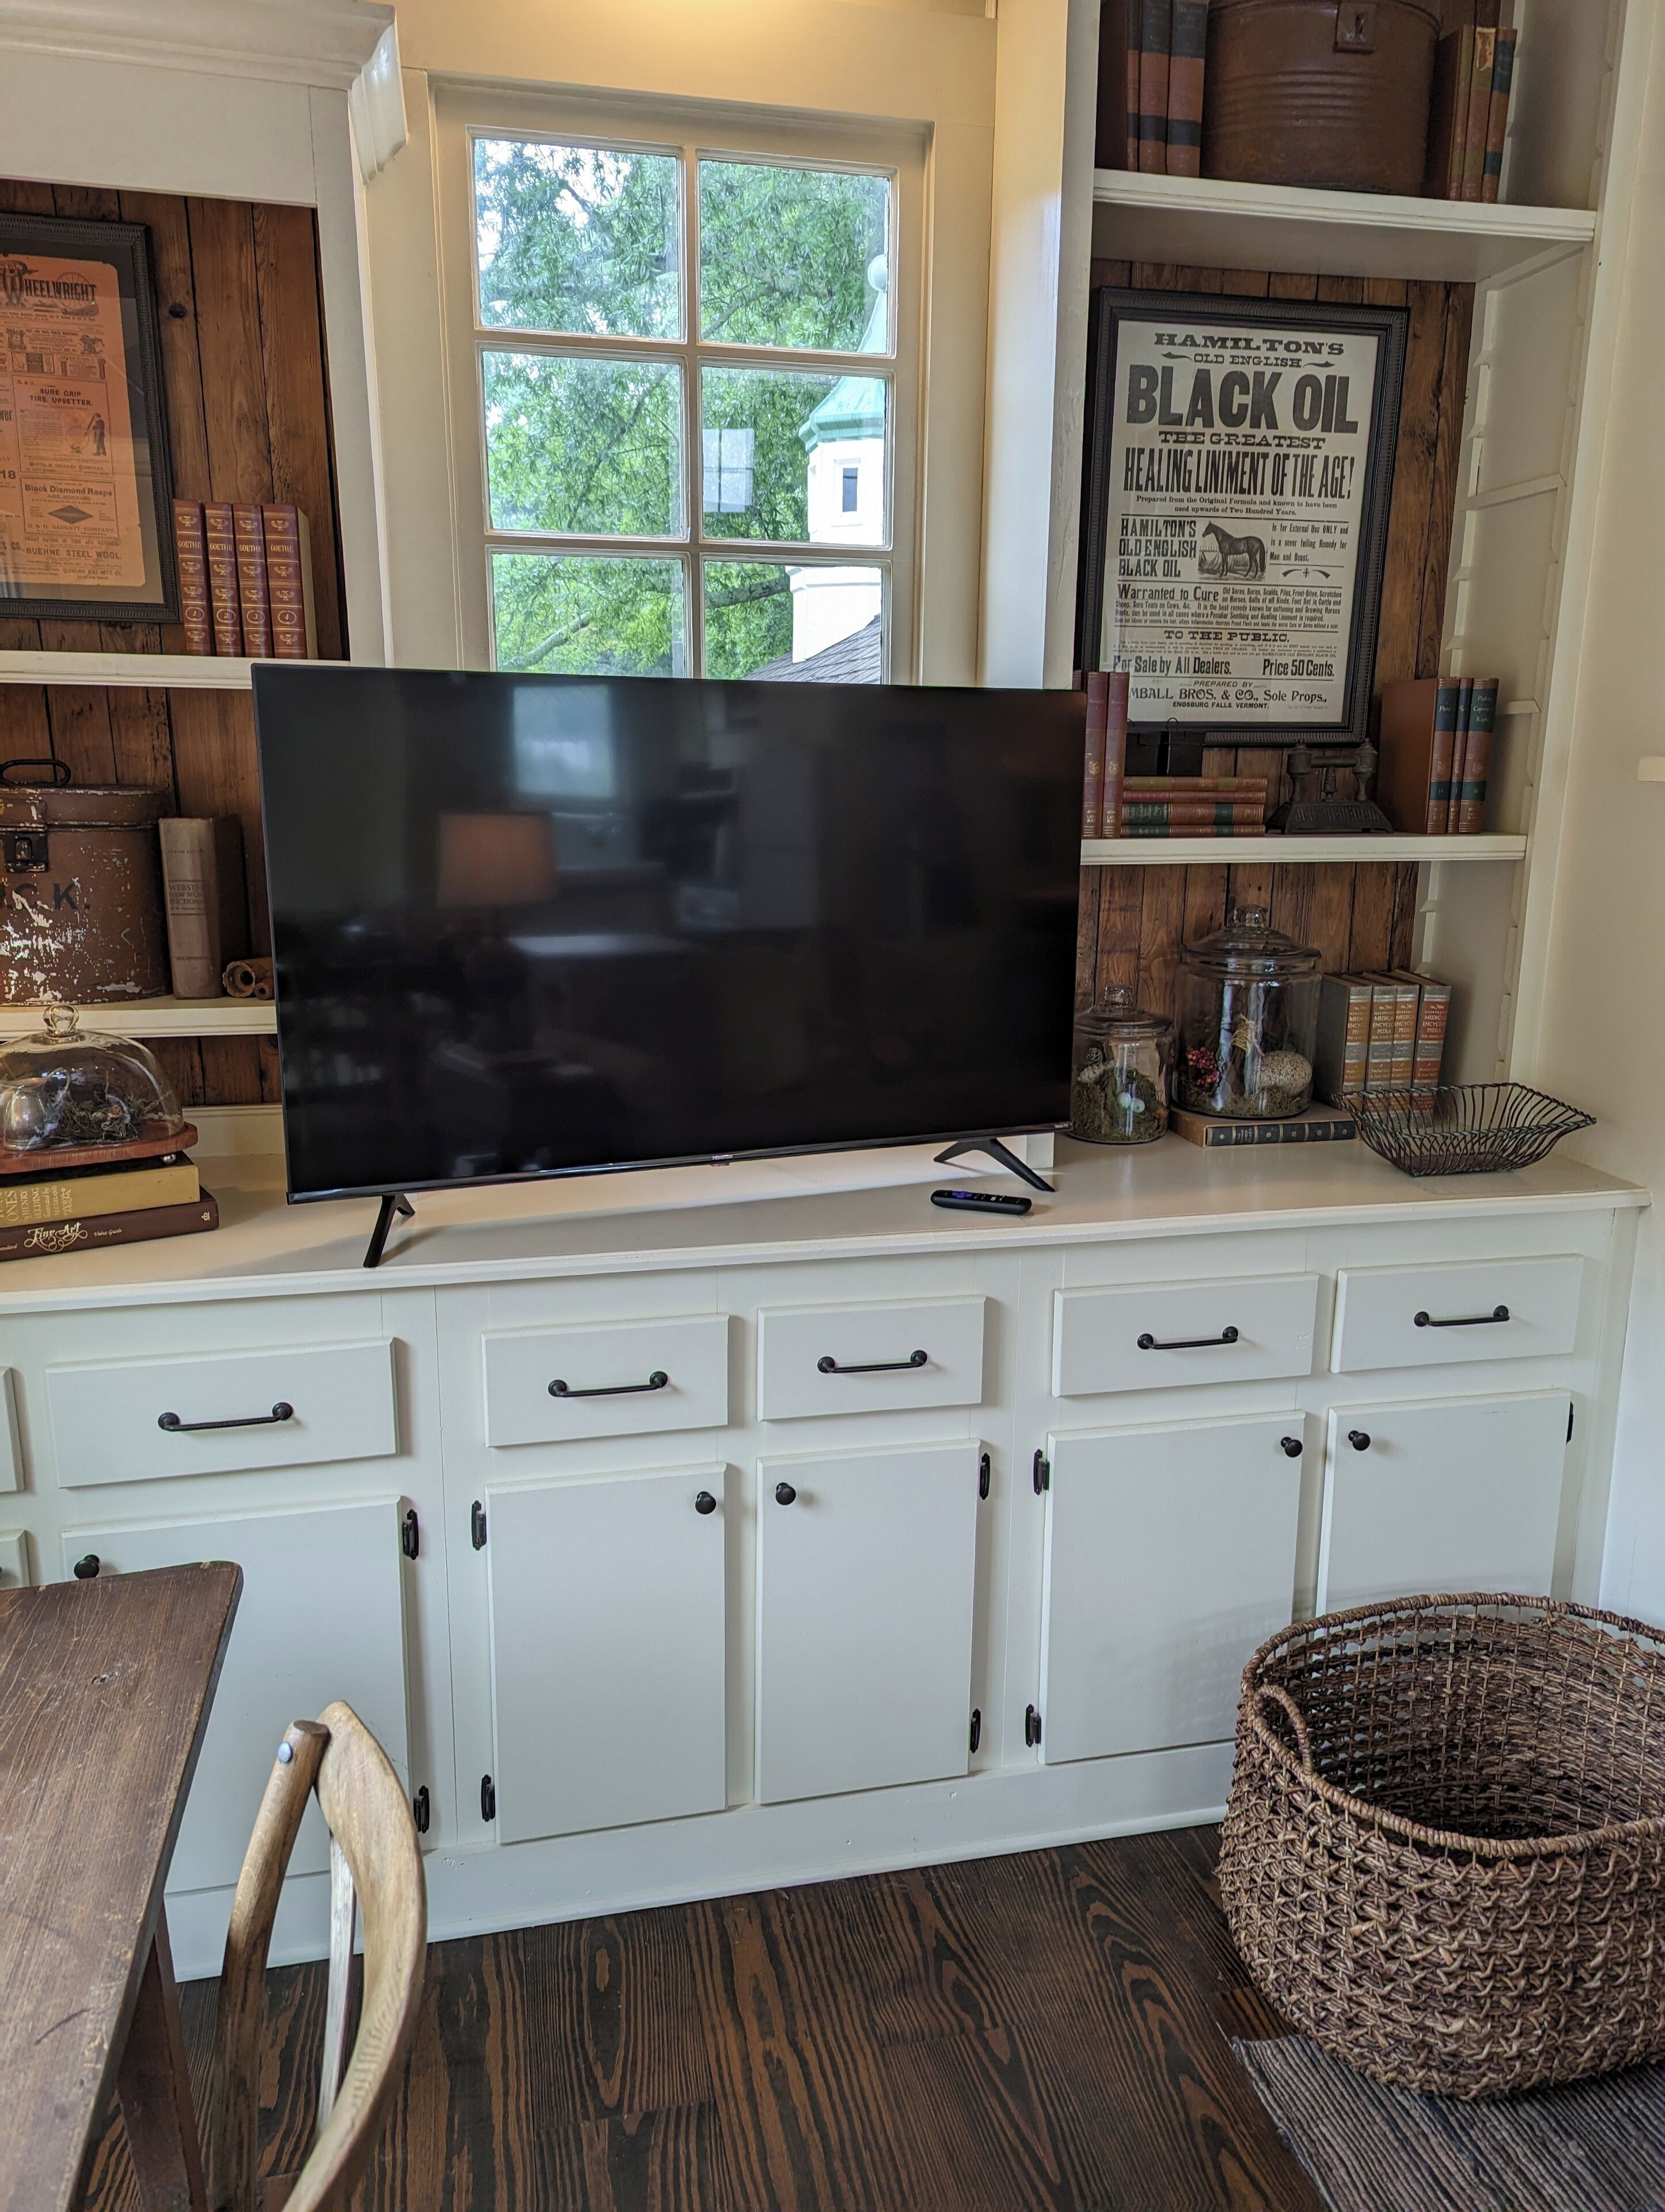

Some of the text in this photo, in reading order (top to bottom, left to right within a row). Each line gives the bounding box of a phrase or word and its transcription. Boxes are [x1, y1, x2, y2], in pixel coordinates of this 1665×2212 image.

[2, 267, 97, 306] WHEELWRIGHT
[1154, 332, 1344, 355] HAMILTON'S
[1194, 353, 1302, 368] OLD ENGLISH
[52, 397, 93, 406] UPSETTER.
[1126, 364, 1359, 434] BLACK OIL
[1158, 431, 1326, 450] THE GREATEST
[1123, 446, 1355, 500] HEALING LINIMENT OF THE AGE!
[24, 484, 48, 493] Black
[50, 486, 86, 494] Diamond
[88, 488, 112, 497] Rasps
[1120, 518, 1197, 538] HAMILTON'S
[1272, 522, 1349, 535] Is for External Use ONLY and
[178, 541, 201, 549] GOETHE
[209, 543, 233, 551] GOETHE
[239, 544, 262, 552] GOETHE
[270, 544, 293, 553] GOETHE
[1119, 539, 1197, 558] OLD ENGLISH
[1270, 537, 1276, 546] is
[1300, 539, 1315, 549] failing
[26, 548, 122, 559] BUEHNE STEEL WOOL.
[1269, 551, 1309, 562] Man and Beast.
[1118, 558, 1181, 577] BLACK OIL
[1117, 584, 1219, 601] Warranted to Cure
[1223, 587, 1231, 595] Old
[1231, 588, 1246, 596] Sores,
[1247, 588, 1262, 596] Burns,
[1263, 588, 1279, 597] Scalds,
[1280, 589, 1292, 597] Piles,
[1319, 590, 1342, 598] Scratches
[1276, 597, 1291, 605] Kinds,
[1230, 612, 1249, 620] Soothing
[1273, 605, 1294, 613] softening
[1305, 607, 1323, 615] Growing
[1164, 630, 1289, 643] TO THE PUBLIC.
[1113, 655, 1334, 677] For Sale by All Dealers. Price 50 Cents.
[1129, 687, 1174, 699] MBALL
[1179, 688, 1216, 700] BROS.
[1221, 690, 1231, 700] &
[1235, 689, 1258, 702] CO.,
[1264, 690, 1287, 701] Sole
[108, 1228, 123, 1236] Guide
